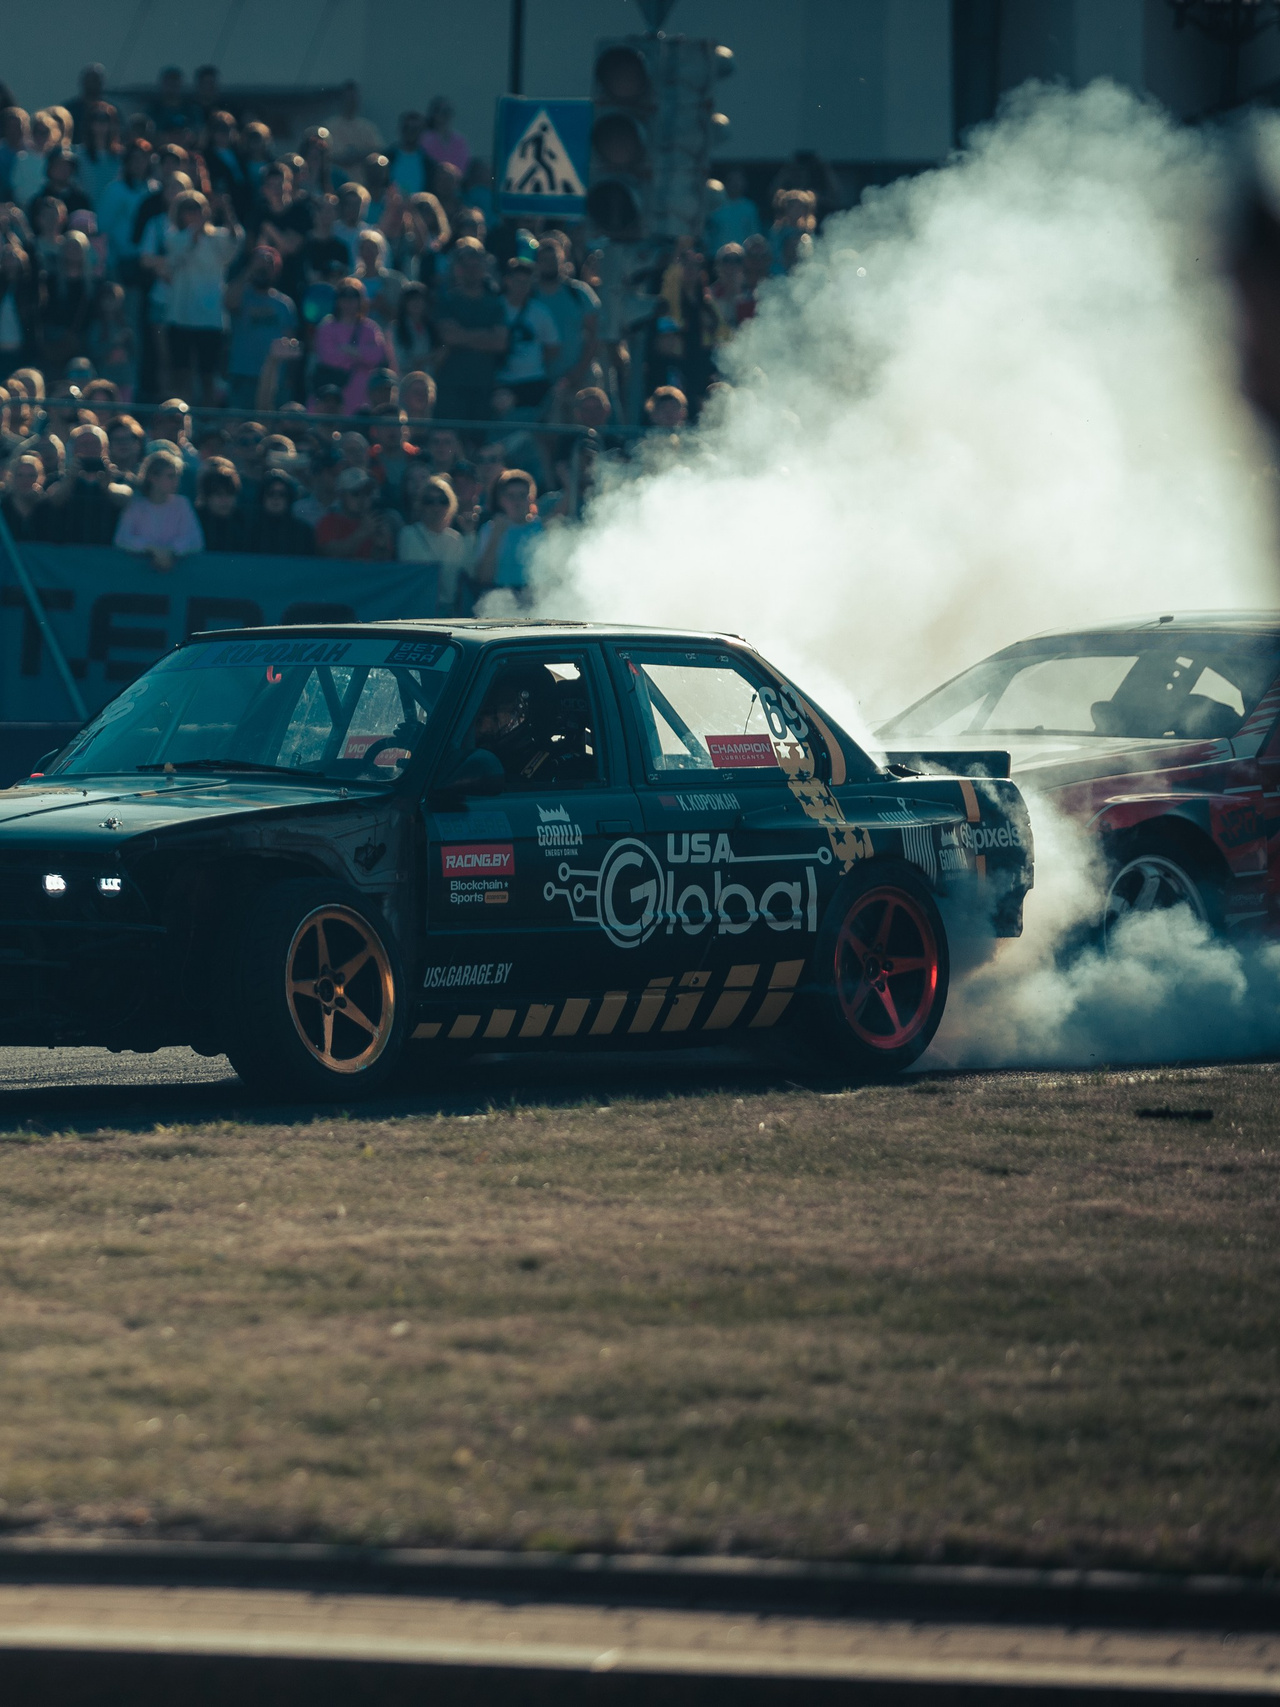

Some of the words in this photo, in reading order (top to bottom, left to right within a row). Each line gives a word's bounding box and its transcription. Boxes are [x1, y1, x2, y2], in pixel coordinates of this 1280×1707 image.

[213, 642, 353, 665] КОРОЖАН
[399, 642, 442, 653] BET
[758, 685, 809, 740] 69
[710, 742, 771, 754] CHAMPION
[536, 823, 583, 847] GORILLA
[545, 849, 563, 857] ENERGY
[563, 848, 578, 856] DRINK
[667, 832, 732, 864] USA
[445, 853, 511, 869] RACING.BY
[450, 879, 503, 891] Blockchain
[450, 892, 483, 904] Sports
[603, 851, 818, 937] Global
